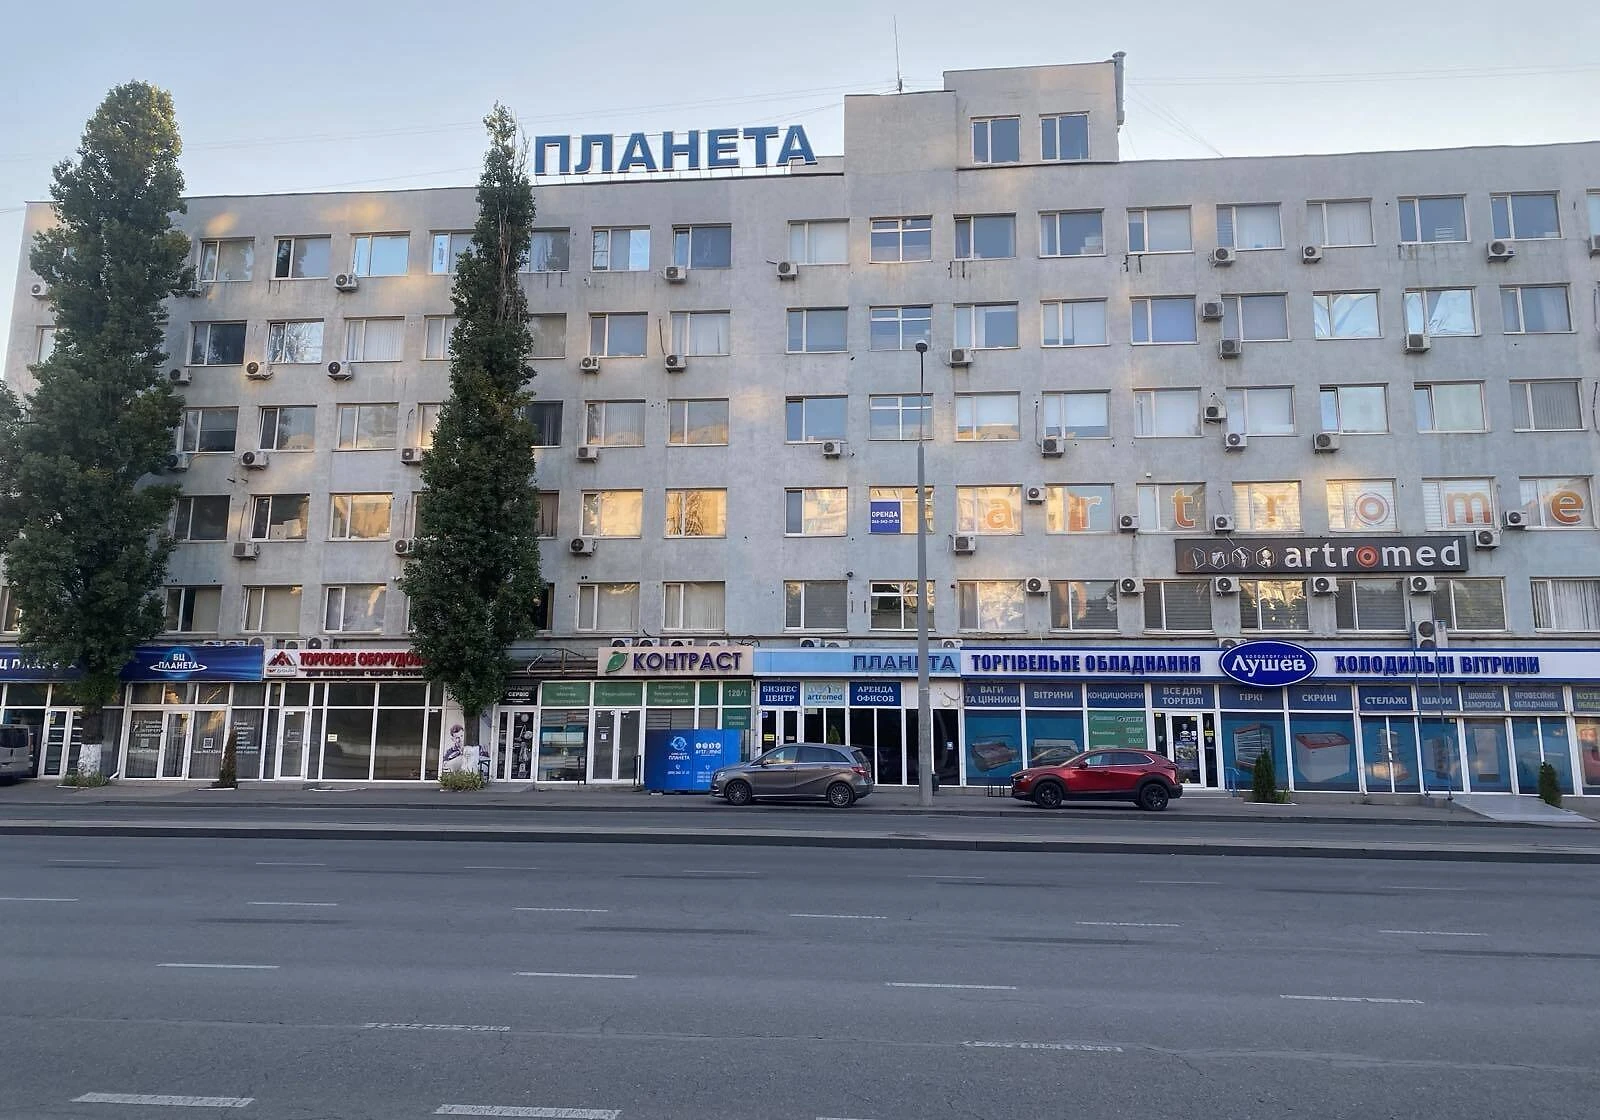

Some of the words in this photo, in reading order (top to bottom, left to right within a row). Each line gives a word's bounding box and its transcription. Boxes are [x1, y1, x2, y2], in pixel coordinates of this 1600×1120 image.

[535, 125, 818, 175] ПЛАНЕТА
[1285, 540, 1460, 567] artromed
[173, 653, 185, 661] БЦ
[300, 653, 356, 666] ТОРГОВОЕ
[159, 661, 199, 670] ПЛАНЕТА
[633, 653, 741, 671] КОНТРАСТ
[853, 655, 956, 671] ПЛАНТА
[972, 655, 1081, 672] ТОРГІВЕЛЬНЕ
[1086, 655, 1201, 674] ОБЛАДНАННЯ
[1231, 655, 1307, 677] Лушев
[1335, 655, 1454, 675] ХОЛОДИЛЬНІ
[1460, 656, 1540, 673] ВІТРИНИ
[762, 685, 798, 693] БИЗНЕС
[857, 686, 893, 694] АРЕНДА
[980, 686, 1004, 694] ВАГИ
[1163, 687, 1182, 695] ВСЕ
[1182, 687, 1202, 696] ДЛЯ
[807, 693, 843, 701] artromed
[856, 695, 894, 703] ОФИСОВ
[978, 695, 1020, 704] ЦІННИКИ
[1033, 691, 1074, 699] ВІТРИНИ
[1087, 691, 1144, 700] КОНДИЦІОНЕРИ
[1302, 694, 1337, 702] СКРИНІ
[1162, 697, 1204, 705] ТОРГІВЛІ
[1364, 696, 1408, 705] СТЕЛАЖІ
